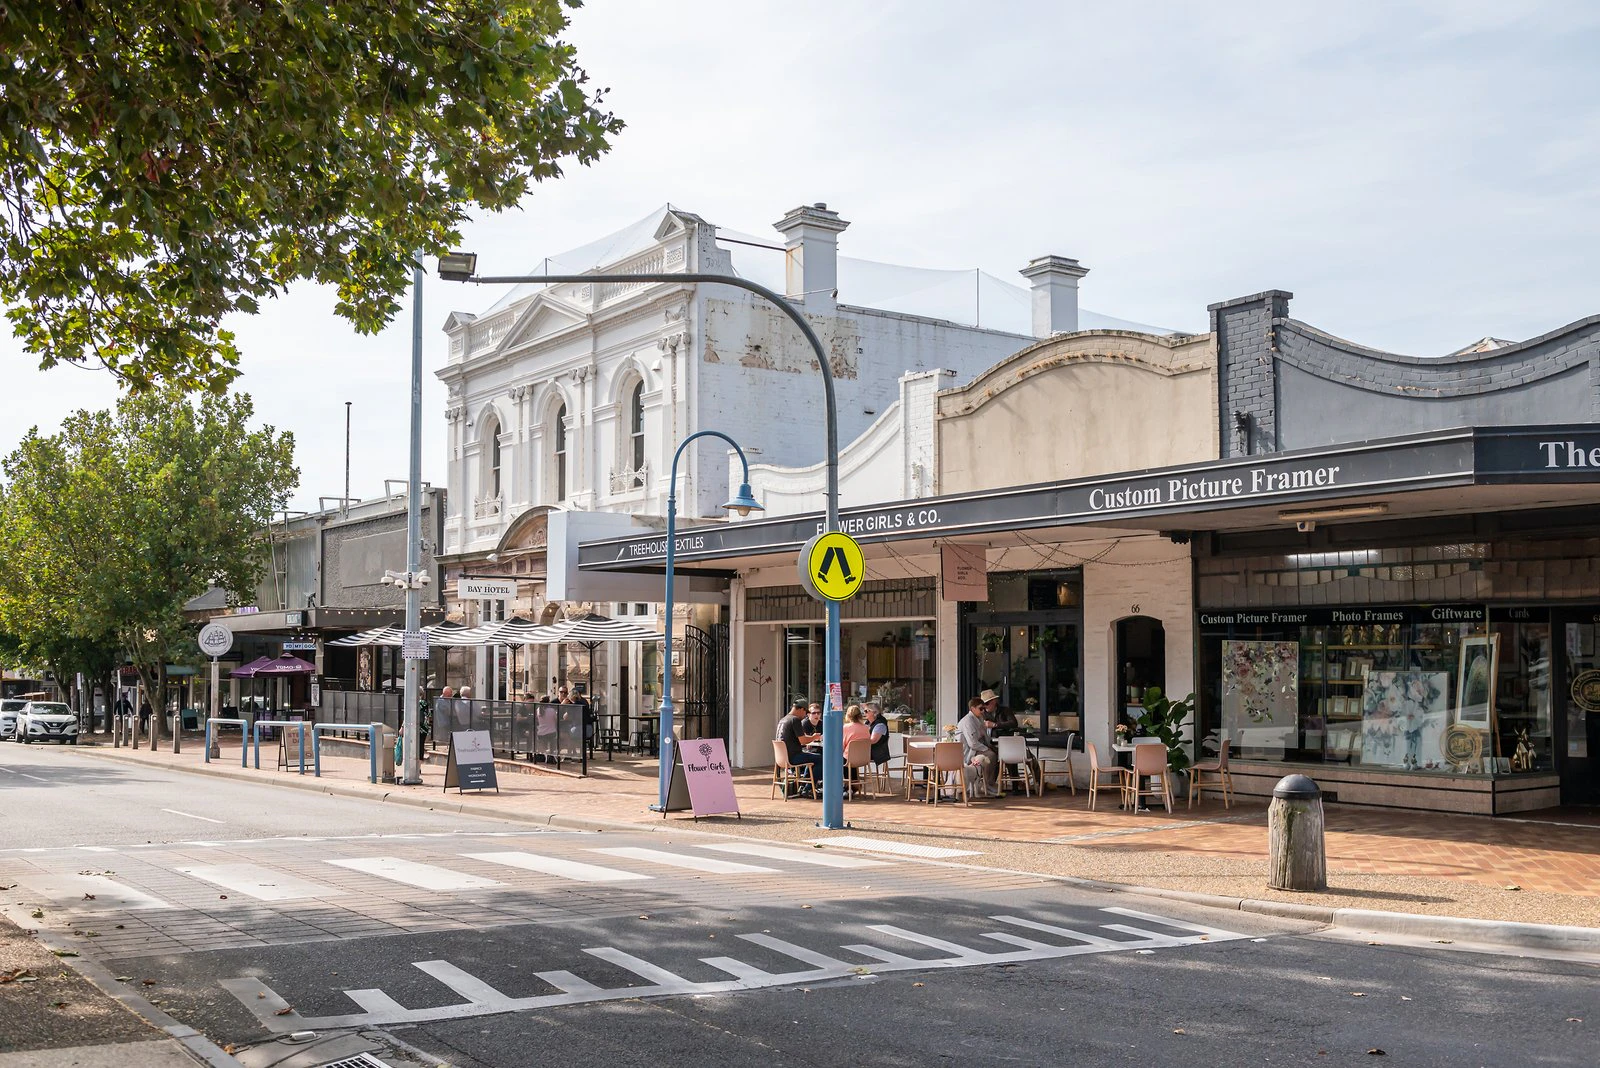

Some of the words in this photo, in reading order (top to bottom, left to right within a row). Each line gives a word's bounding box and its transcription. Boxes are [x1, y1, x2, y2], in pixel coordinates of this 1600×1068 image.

[1539, 441, 1600, 467] The
[1089, 487, 1161, 510] Custom
[1167, 478, 1243, 502] Picture
[1250, 466, 1340, 493] Framer
[866, 513, 903, 531] GIRLS
[907, 512, 915, 526] &
[918, 509, 941, 525] CO.
[674, 536, 704, 551] EXTILES
[467, 585, 482, 593] BAY
[484, 586, 510, 594] HOTEL
[1131, 604, 1140, 613] 66
[1431, 607, 1482, 620] Giftware
[1508, 607, 1530, 618] Cards
[1200, 613, 1234, 624] Custom
[1236, 613, 1269, 624] Picture
[1271, 612, 1307, 623] Framer
[1332, 610, 1361, 622] Photo
[1364, 609, 1404, 621] Frames
[687, 763, 708, 772] Flower
[709, 761, 725, 771] Girls
